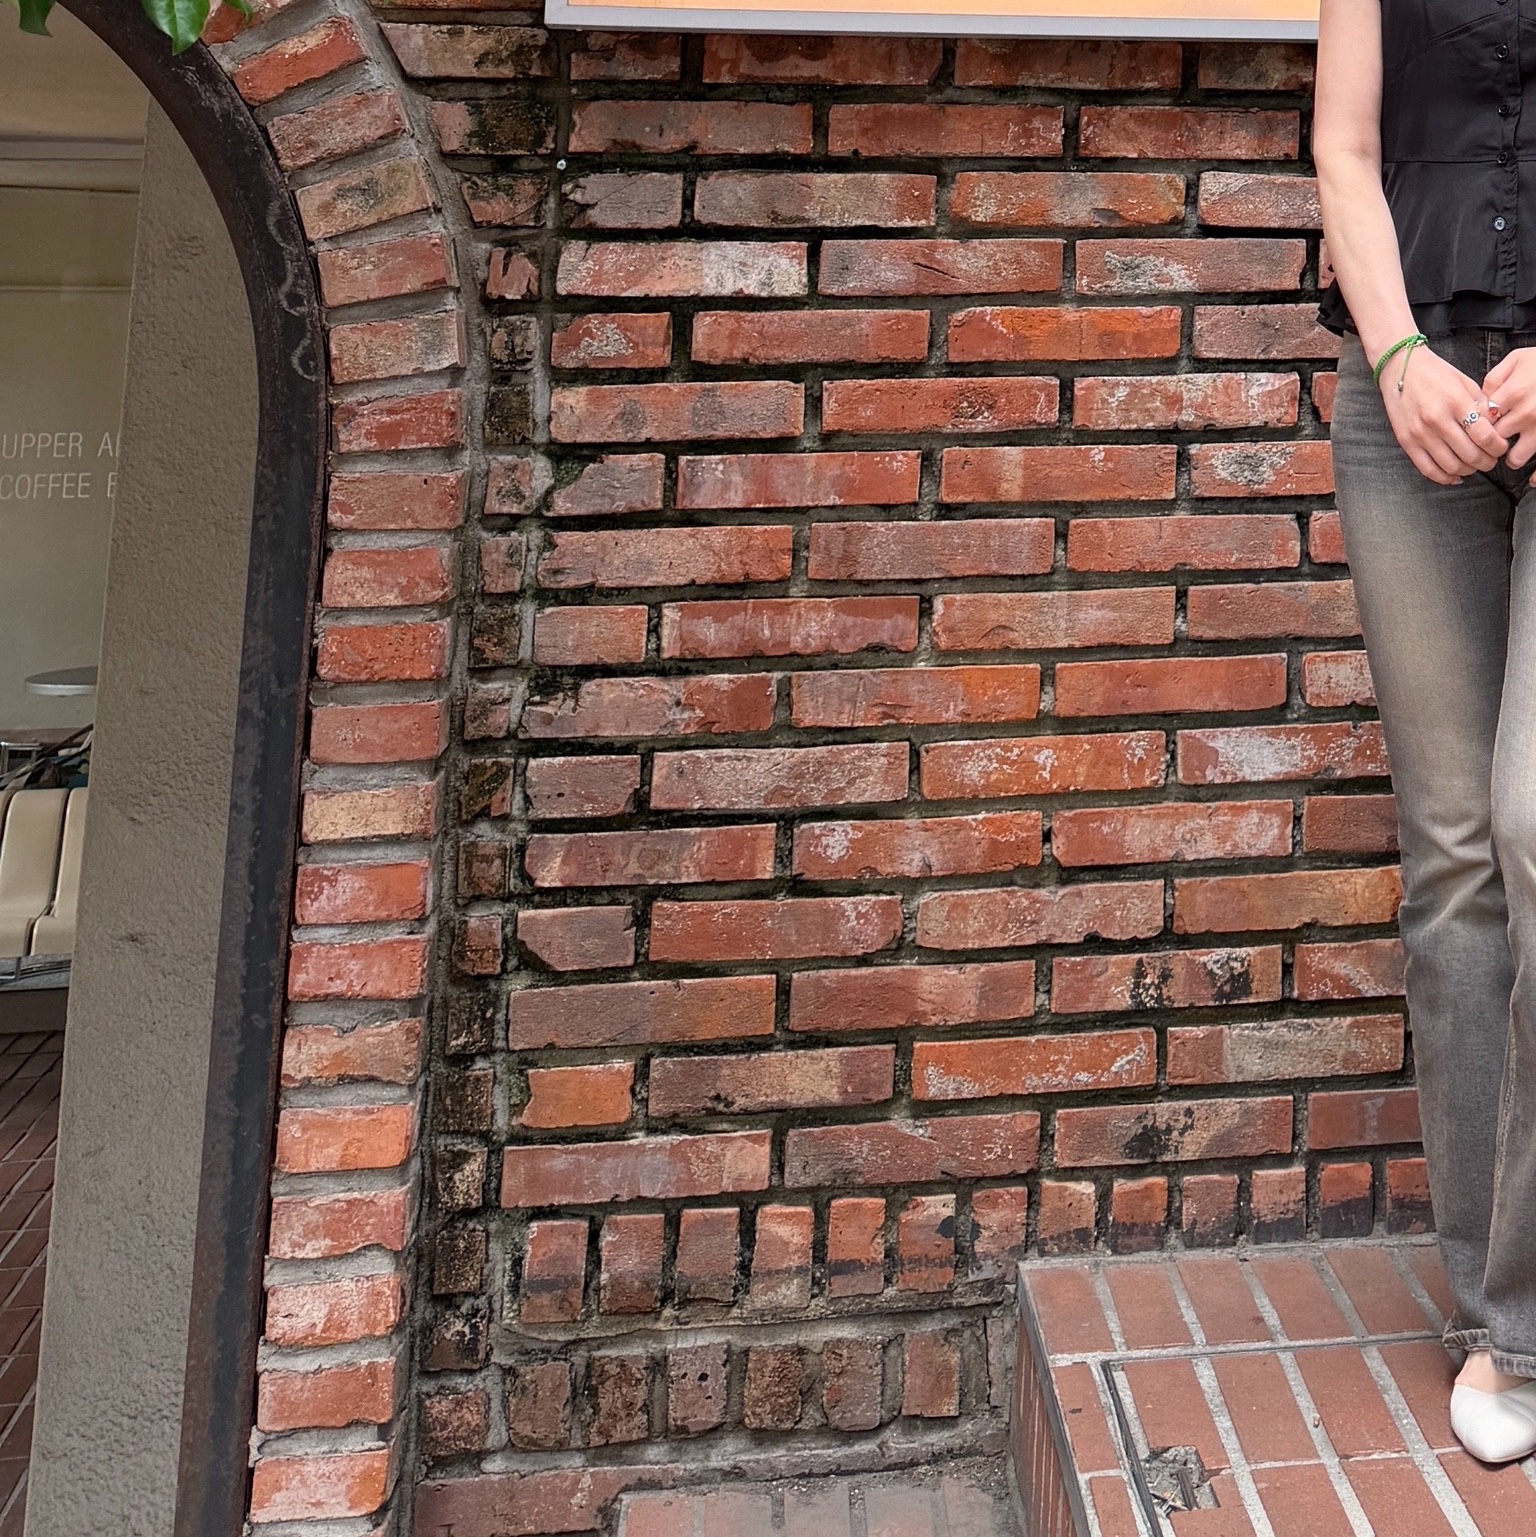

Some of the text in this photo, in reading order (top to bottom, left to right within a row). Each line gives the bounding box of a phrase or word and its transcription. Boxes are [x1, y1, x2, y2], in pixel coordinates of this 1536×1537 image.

[2, 431, 121, 460] UPPER A
[0, 472, 92, 500] COFFEE
